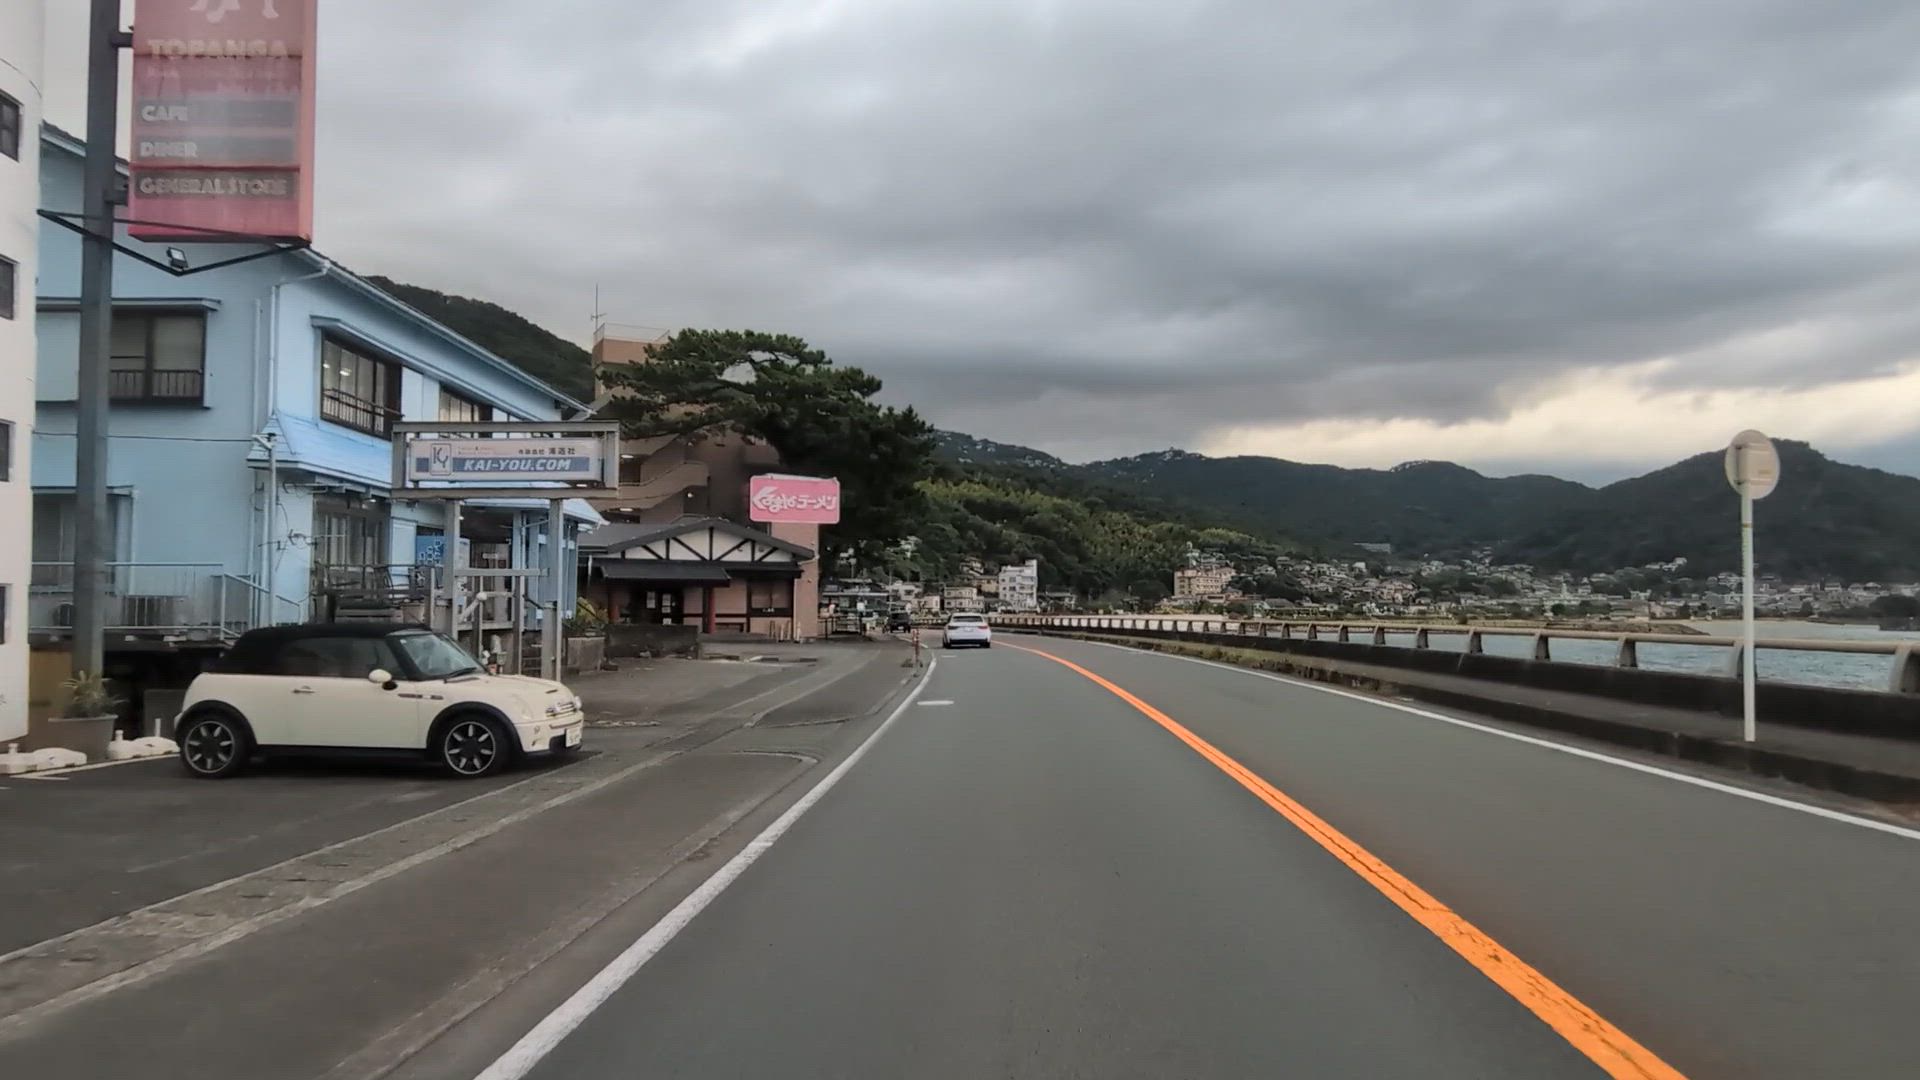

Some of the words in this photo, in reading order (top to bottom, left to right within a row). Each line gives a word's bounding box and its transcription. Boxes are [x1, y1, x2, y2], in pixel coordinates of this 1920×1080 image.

[147, 38, 288, 59] TOPANGA
[141, 104, 188, 122] CAFE
[140, 141, 198, 158] DINER
[140, 176, 225, 195] GENERAL
[228, 176, 287, 196] STORE
[463, 458, 571, 472] KAI-YOU.COM
